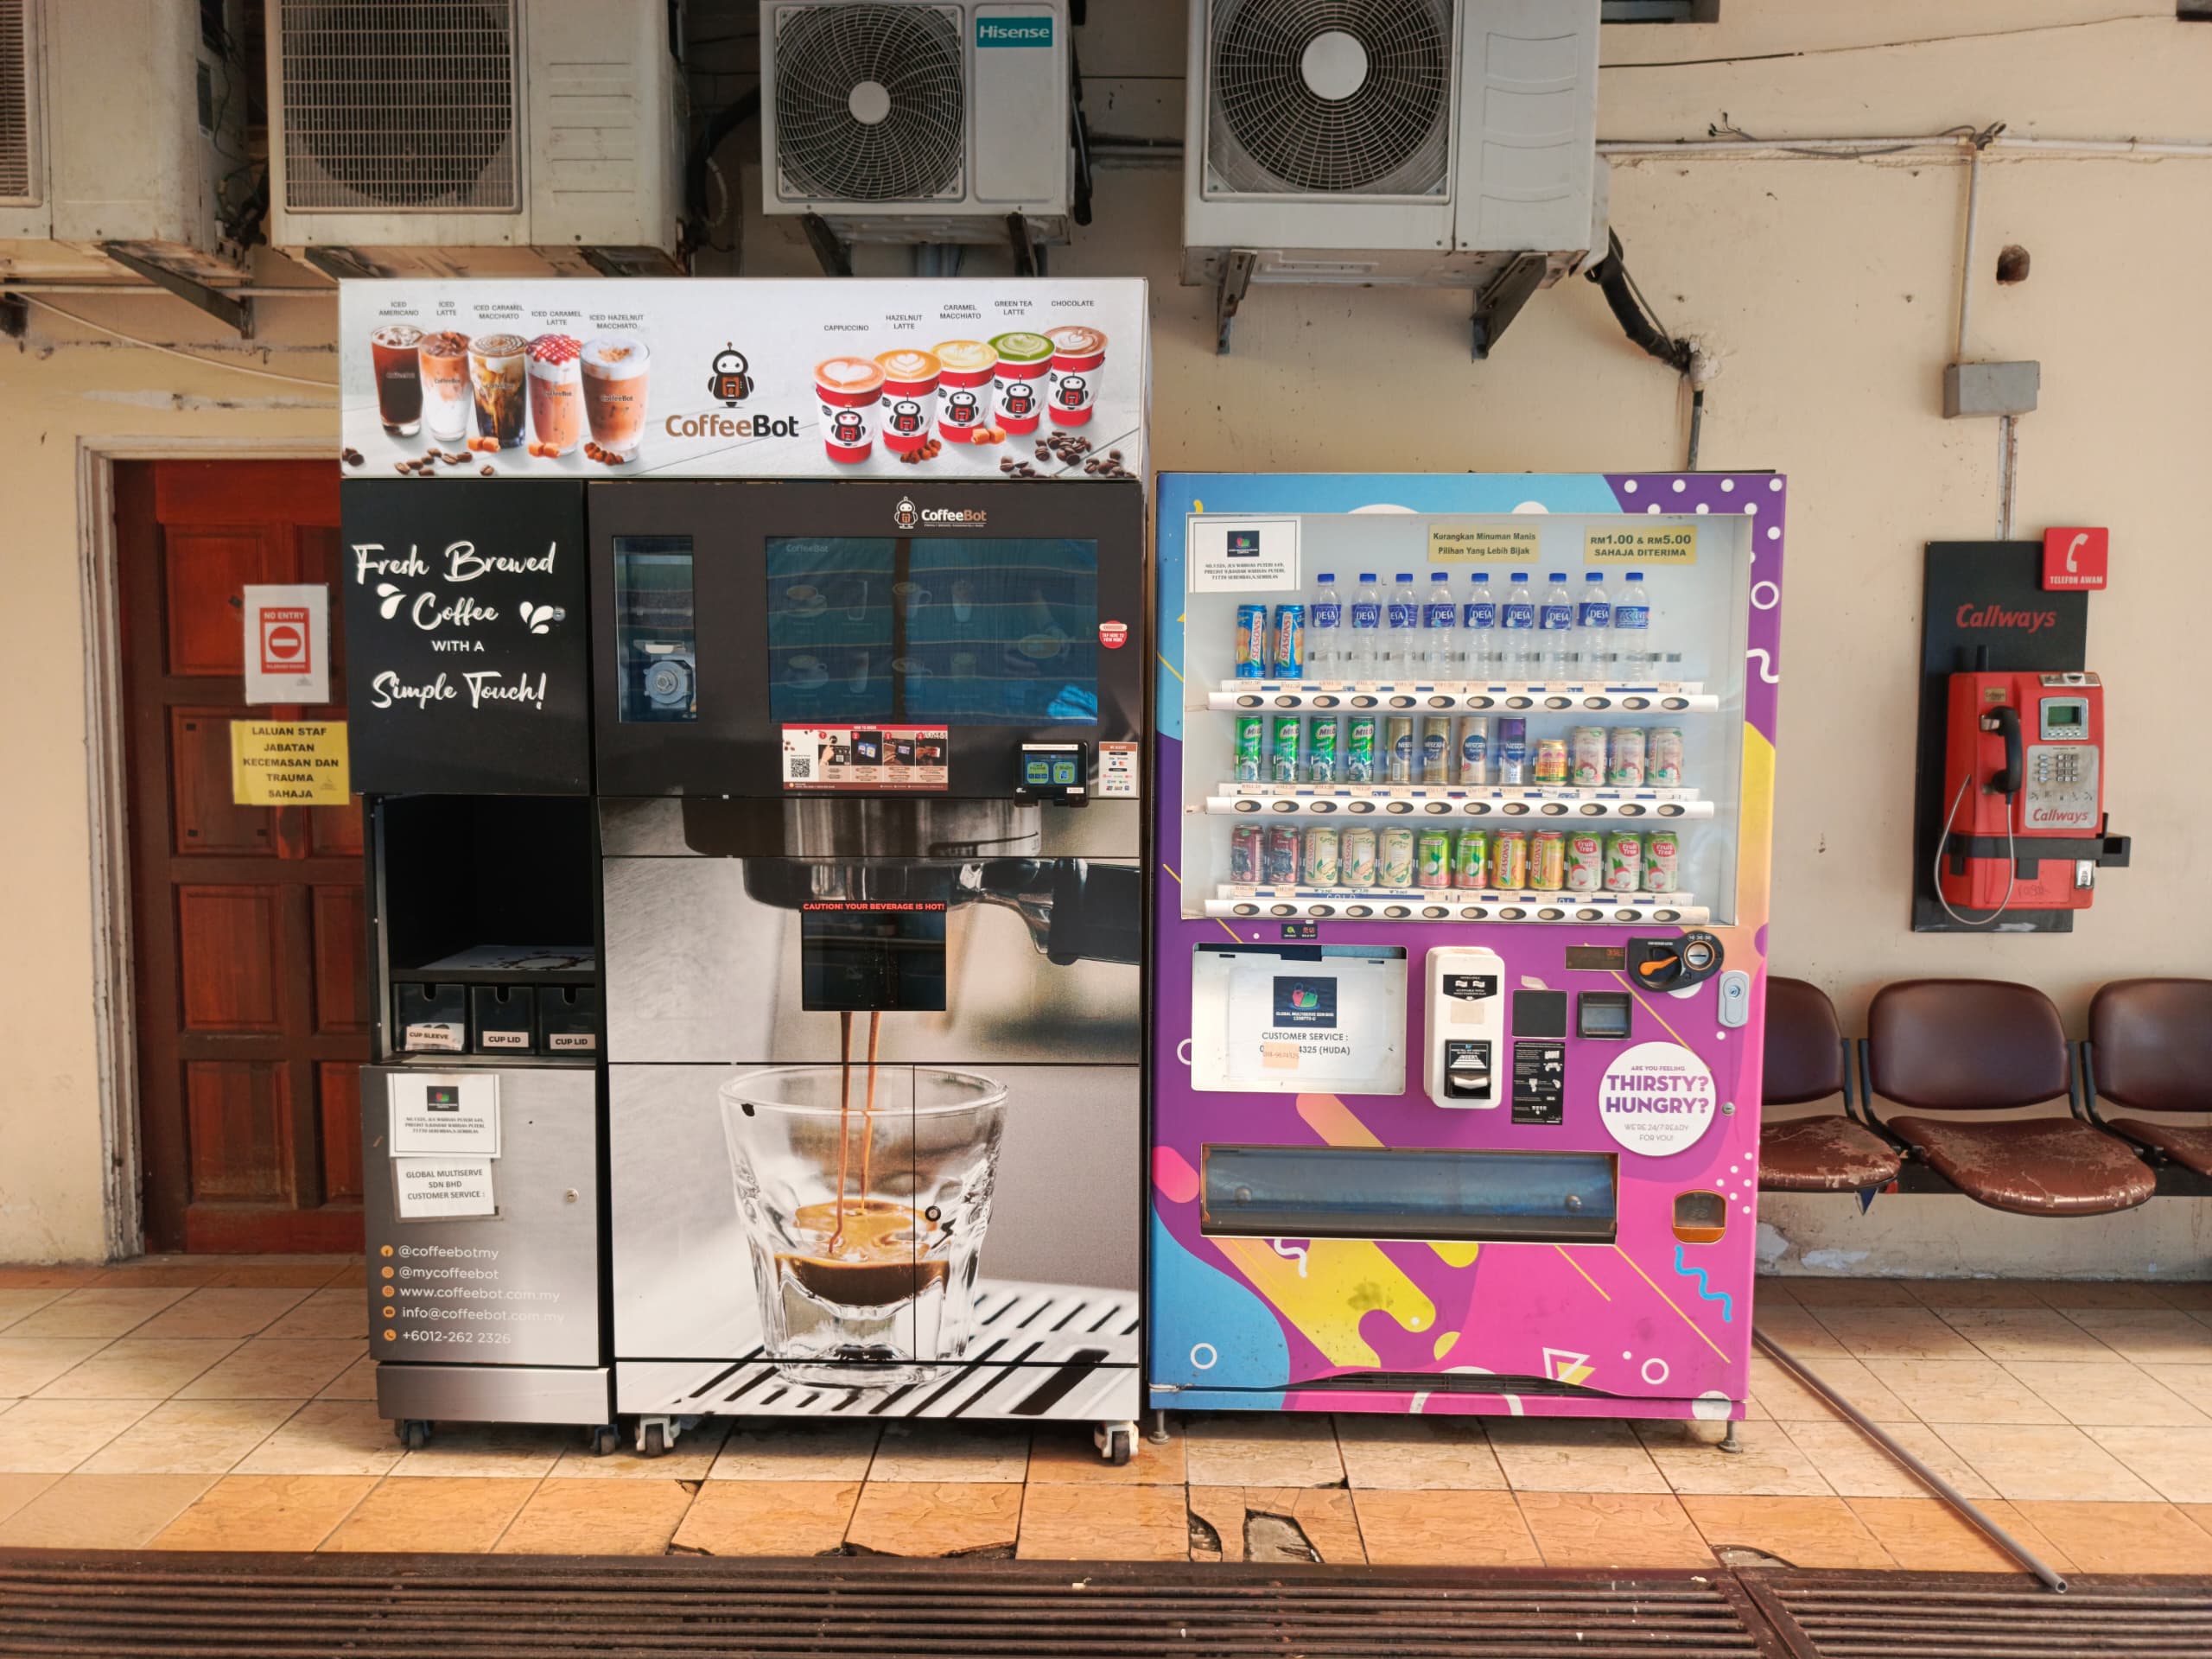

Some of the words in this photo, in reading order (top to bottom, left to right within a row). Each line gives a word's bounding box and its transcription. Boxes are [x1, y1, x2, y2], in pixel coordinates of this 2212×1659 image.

[979, 25, 1050, 39] Hisense
[665, 414, 799, 437] CoffeeBot
[921, 509, 987, 521] CoffeeBot
[1433, 532, 1474, 542] Kurangkan
[1590, 534, 1634, 544] RM1.00
[1647, 534, 1692, 545] RM5.00
[1466, 547, 1485, 557] Yang
[1487, 546, 1508, 555] Lebih
[1510, 546, 1530, 556] Bijak
[352, 543, 429, 585] Fresh
[442, 540, 556, 582] Brewed
[2050, 575, 2078, 584] TELEFON
[2080, 575, 2102, 584] AWAM
[412, 591, 499, 631] Coffee
[1955, 603, 2056, 633] Callways
[431, 640, 469, 652] WITH
[474, 640, 485, 652] A
[1252, 620, 1262, 659] SEASONS
[1281, 620, 1291, 659] SEASONS
[371, 671, 457, 709] Simple
[462, 671, 547, 709] Touch!
[1355, 728, 1373, 736] MILO
[264, 743, 315, 752] JABATAN
[315, 759, 339, 767] DAN
[266, 773, 314, 782] TRAUMA
[269, 790, 313, 798] SAHAJA
[2032, 808, 2088, 823] Callways
[1501, 842, 1510, 877] SEASONS
[1262, 1032, 1306, 1040] CUSTOMER
[1309, 1033, 1344, 1041] SERVICE
[1319, 1046, 1351, 1056] (HUDA)
[1606, 1075, 1709, 1091] THIRSTY?
[1605, 1096, 1709, 1114] HUNGRY?
[406, 1170, 435, 1179] GLOBAL
[436, 1169, 483, 1178] MULTISERVE
[407, 1192, 449, 1200] CUSTOMER
[450, 1190, 480, 1198] SERVICE
[398, 1244, 499, 1261] @coffeebotmy
[399, 1266, 499, 1281] @mycoffeebot
[399, 1287, 561, 1303] www.coffeebot.com.my
[403, 1330, 474, 1344] +6012-262
[477, 1332, 512, 1344] 2326
